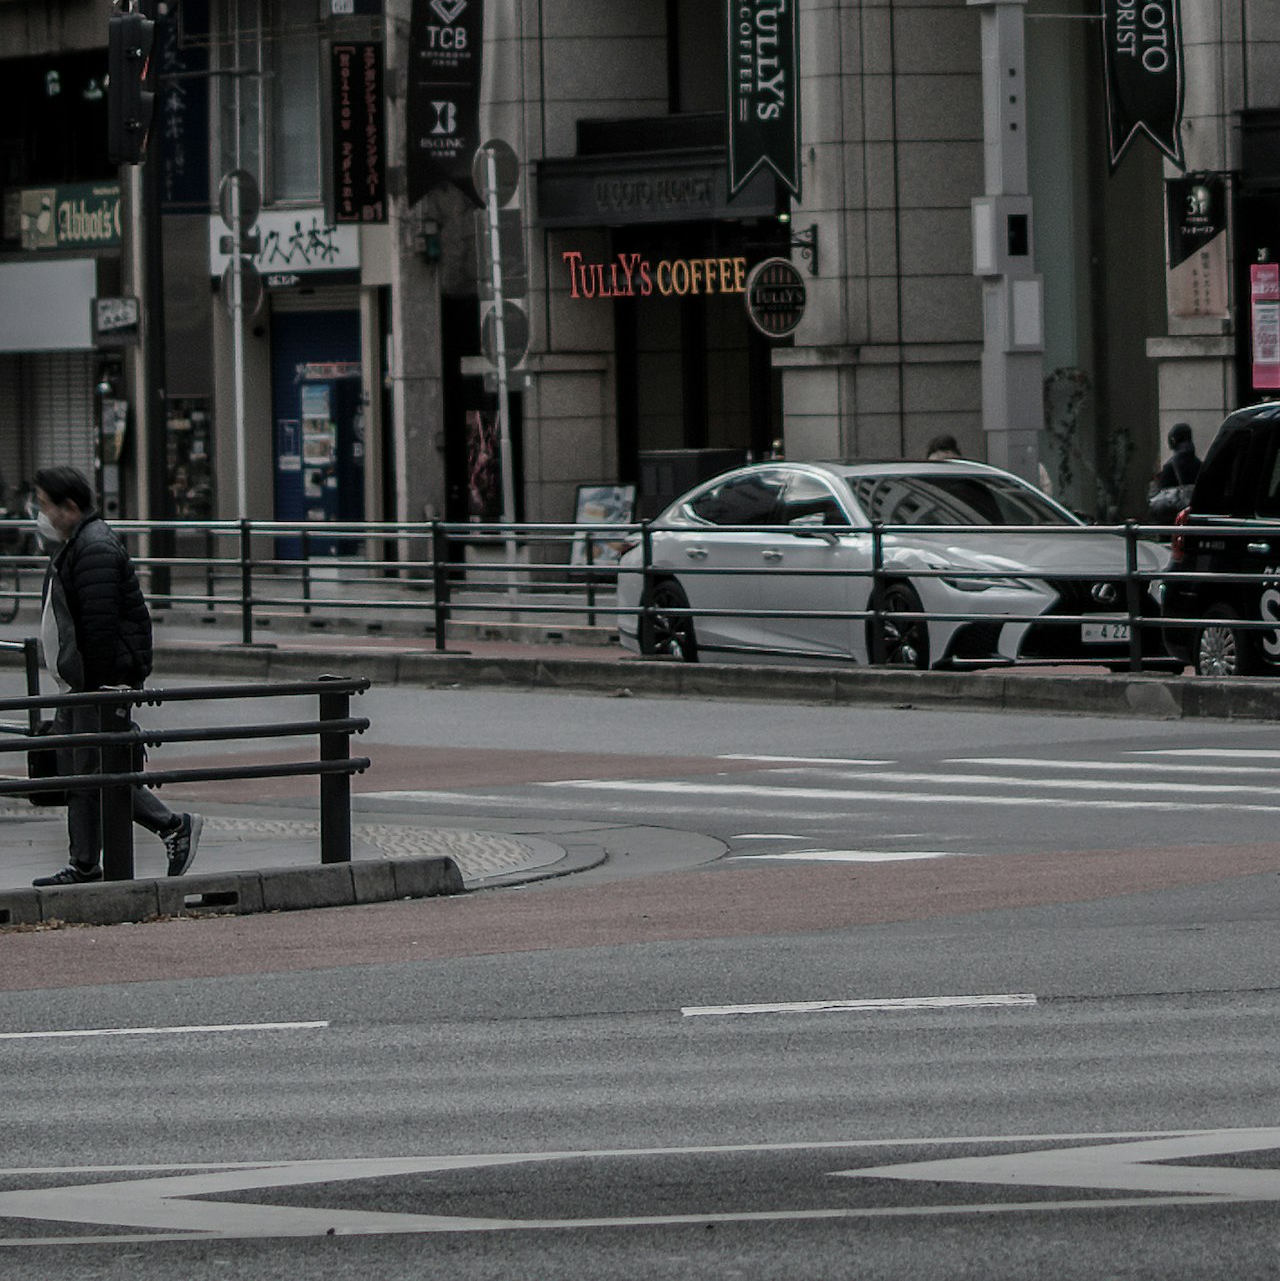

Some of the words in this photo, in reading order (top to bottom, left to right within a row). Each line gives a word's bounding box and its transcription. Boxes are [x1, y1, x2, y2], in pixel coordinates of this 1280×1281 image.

[427, 25, 468, 50] TCB
[739, 6, 752, 94] COFFEE
[562, 250, 653, 299] TULLY'S
[656, 256, 748, 297] COFFEE
